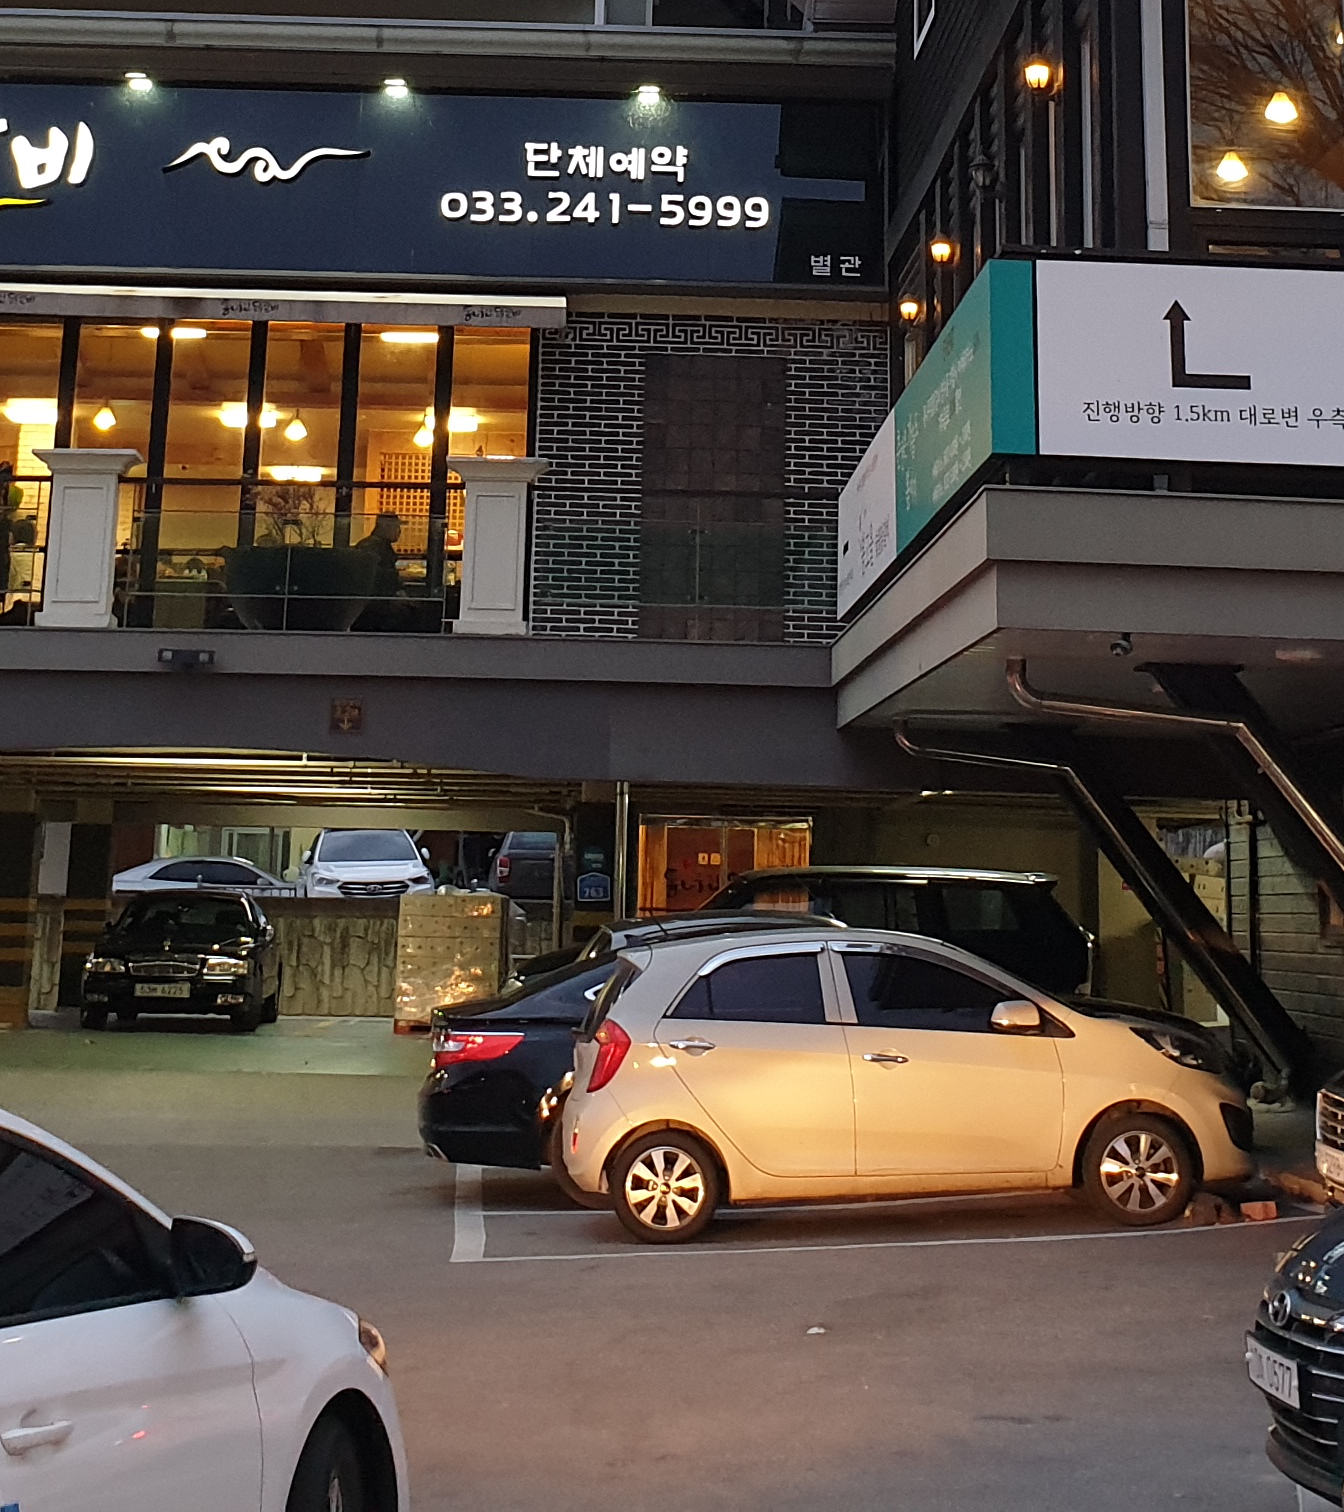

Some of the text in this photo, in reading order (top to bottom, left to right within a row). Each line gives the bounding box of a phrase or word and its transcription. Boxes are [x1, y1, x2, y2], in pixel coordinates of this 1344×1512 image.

[523, 141, 690, 182] 단체예약
[439, 190, 771, 229] 033.241-5999
[809, 254, 862, 278] 별관
[1081, 398, 1166, 424] 진행방향
[1173, 402, 1231, 425] 1.5km
[1238, 404, 1300, 430] 대로변
